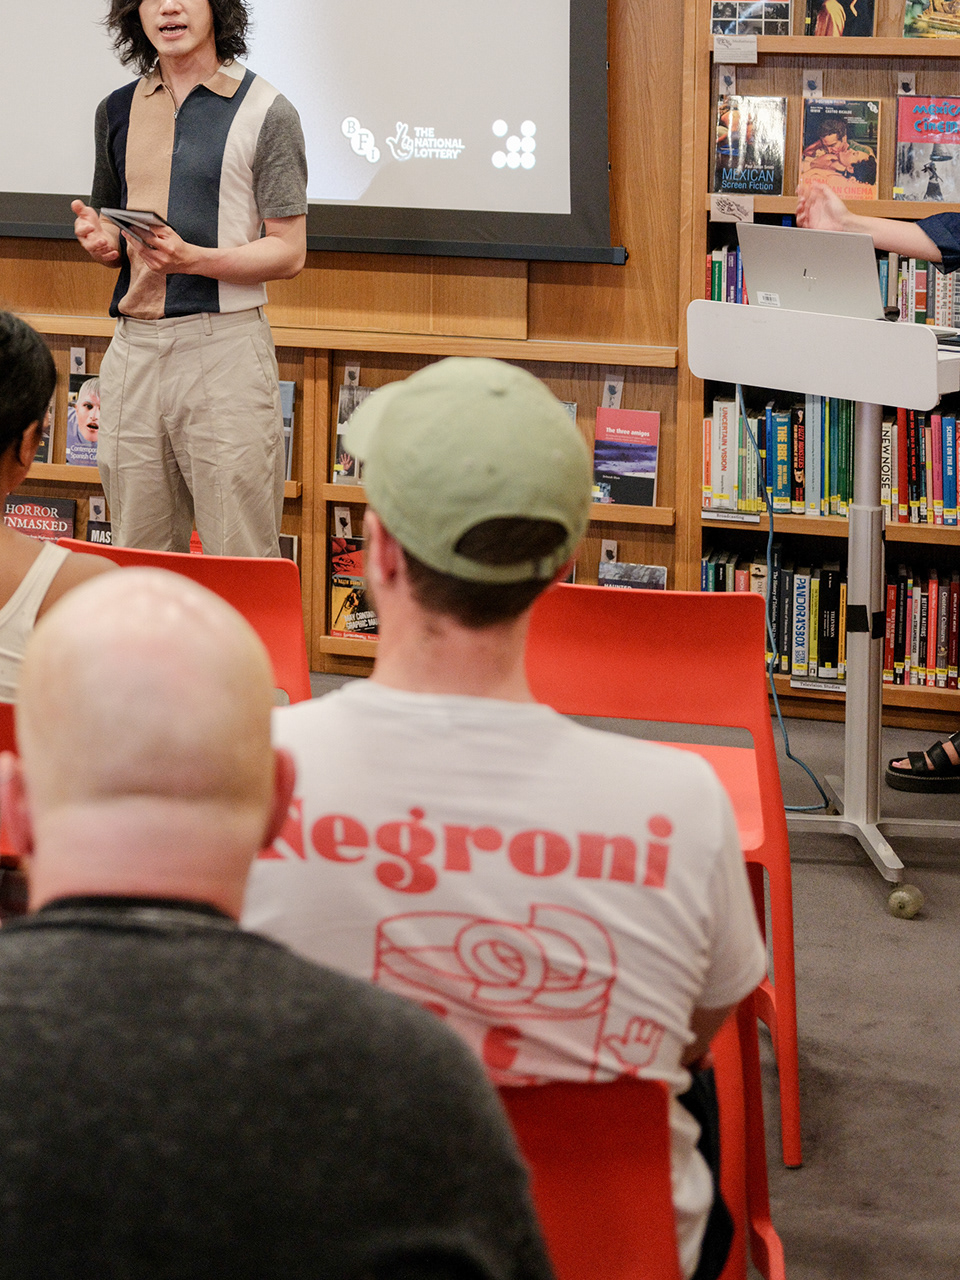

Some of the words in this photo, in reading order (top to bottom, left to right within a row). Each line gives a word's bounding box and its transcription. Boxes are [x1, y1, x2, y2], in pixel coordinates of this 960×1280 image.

[414, 127, 434, 138] THE
[414, 138, 465, 149] NATIONAL
[414, 149, 461, 159] LOTTERY
[722, 167, 775, 182] MEXICAN
[721, 180, 747, 189] Screen
[749, 182, 774, 190] Fiction
[844, 186, 873, 195] CINEMA
[777, 426, 787, 442] THE
[881, 430, 890, 456] NEW
[777, 444, 787, 461] BBC
[881, 456, 890, 489] NOISE
[5, 503, 59, 518] HORROR
[716, 513, 744, 521] Broadcasting
[795, 577, 807, 630] PANDORA'S
[795, 631, 805, 648] BOX
[800, 681, 822, 689] Television
